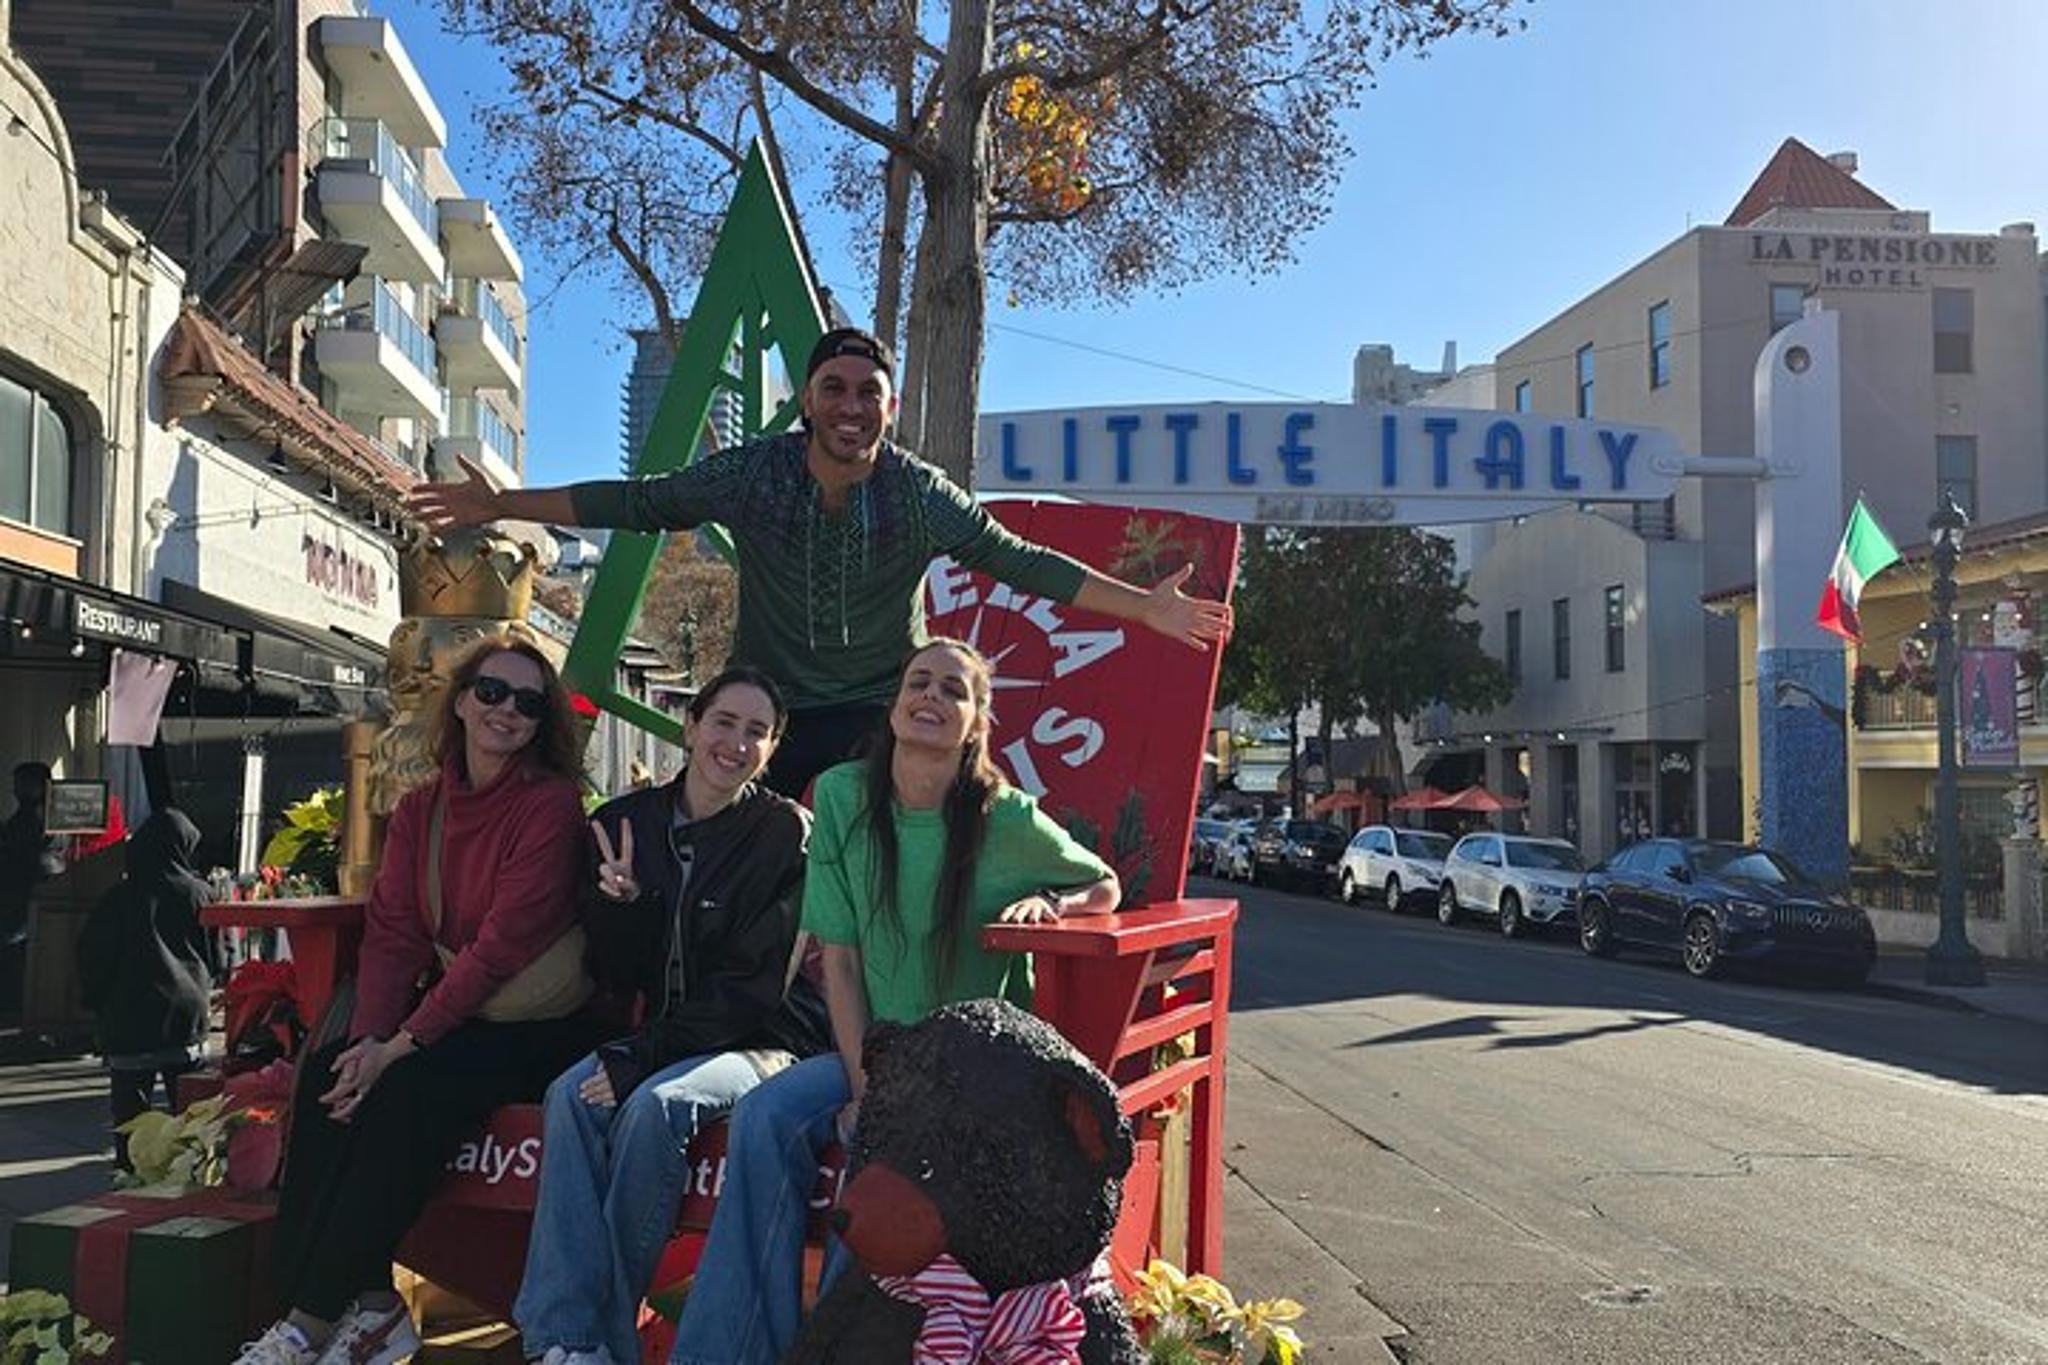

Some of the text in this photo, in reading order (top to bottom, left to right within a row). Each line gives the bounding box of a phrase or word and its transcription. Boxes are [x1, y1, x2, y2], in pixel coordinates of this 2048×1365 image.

[1751, 235, 1998, 265] LA PENSIONE
[1825, 269, 1923, 287] HOTEL
[1001, 411, 1640, 490] LITTLE ITALY
[78, 600, 161, 644] RESTAURANT
[445, 1133, 542, 1185] alyS
